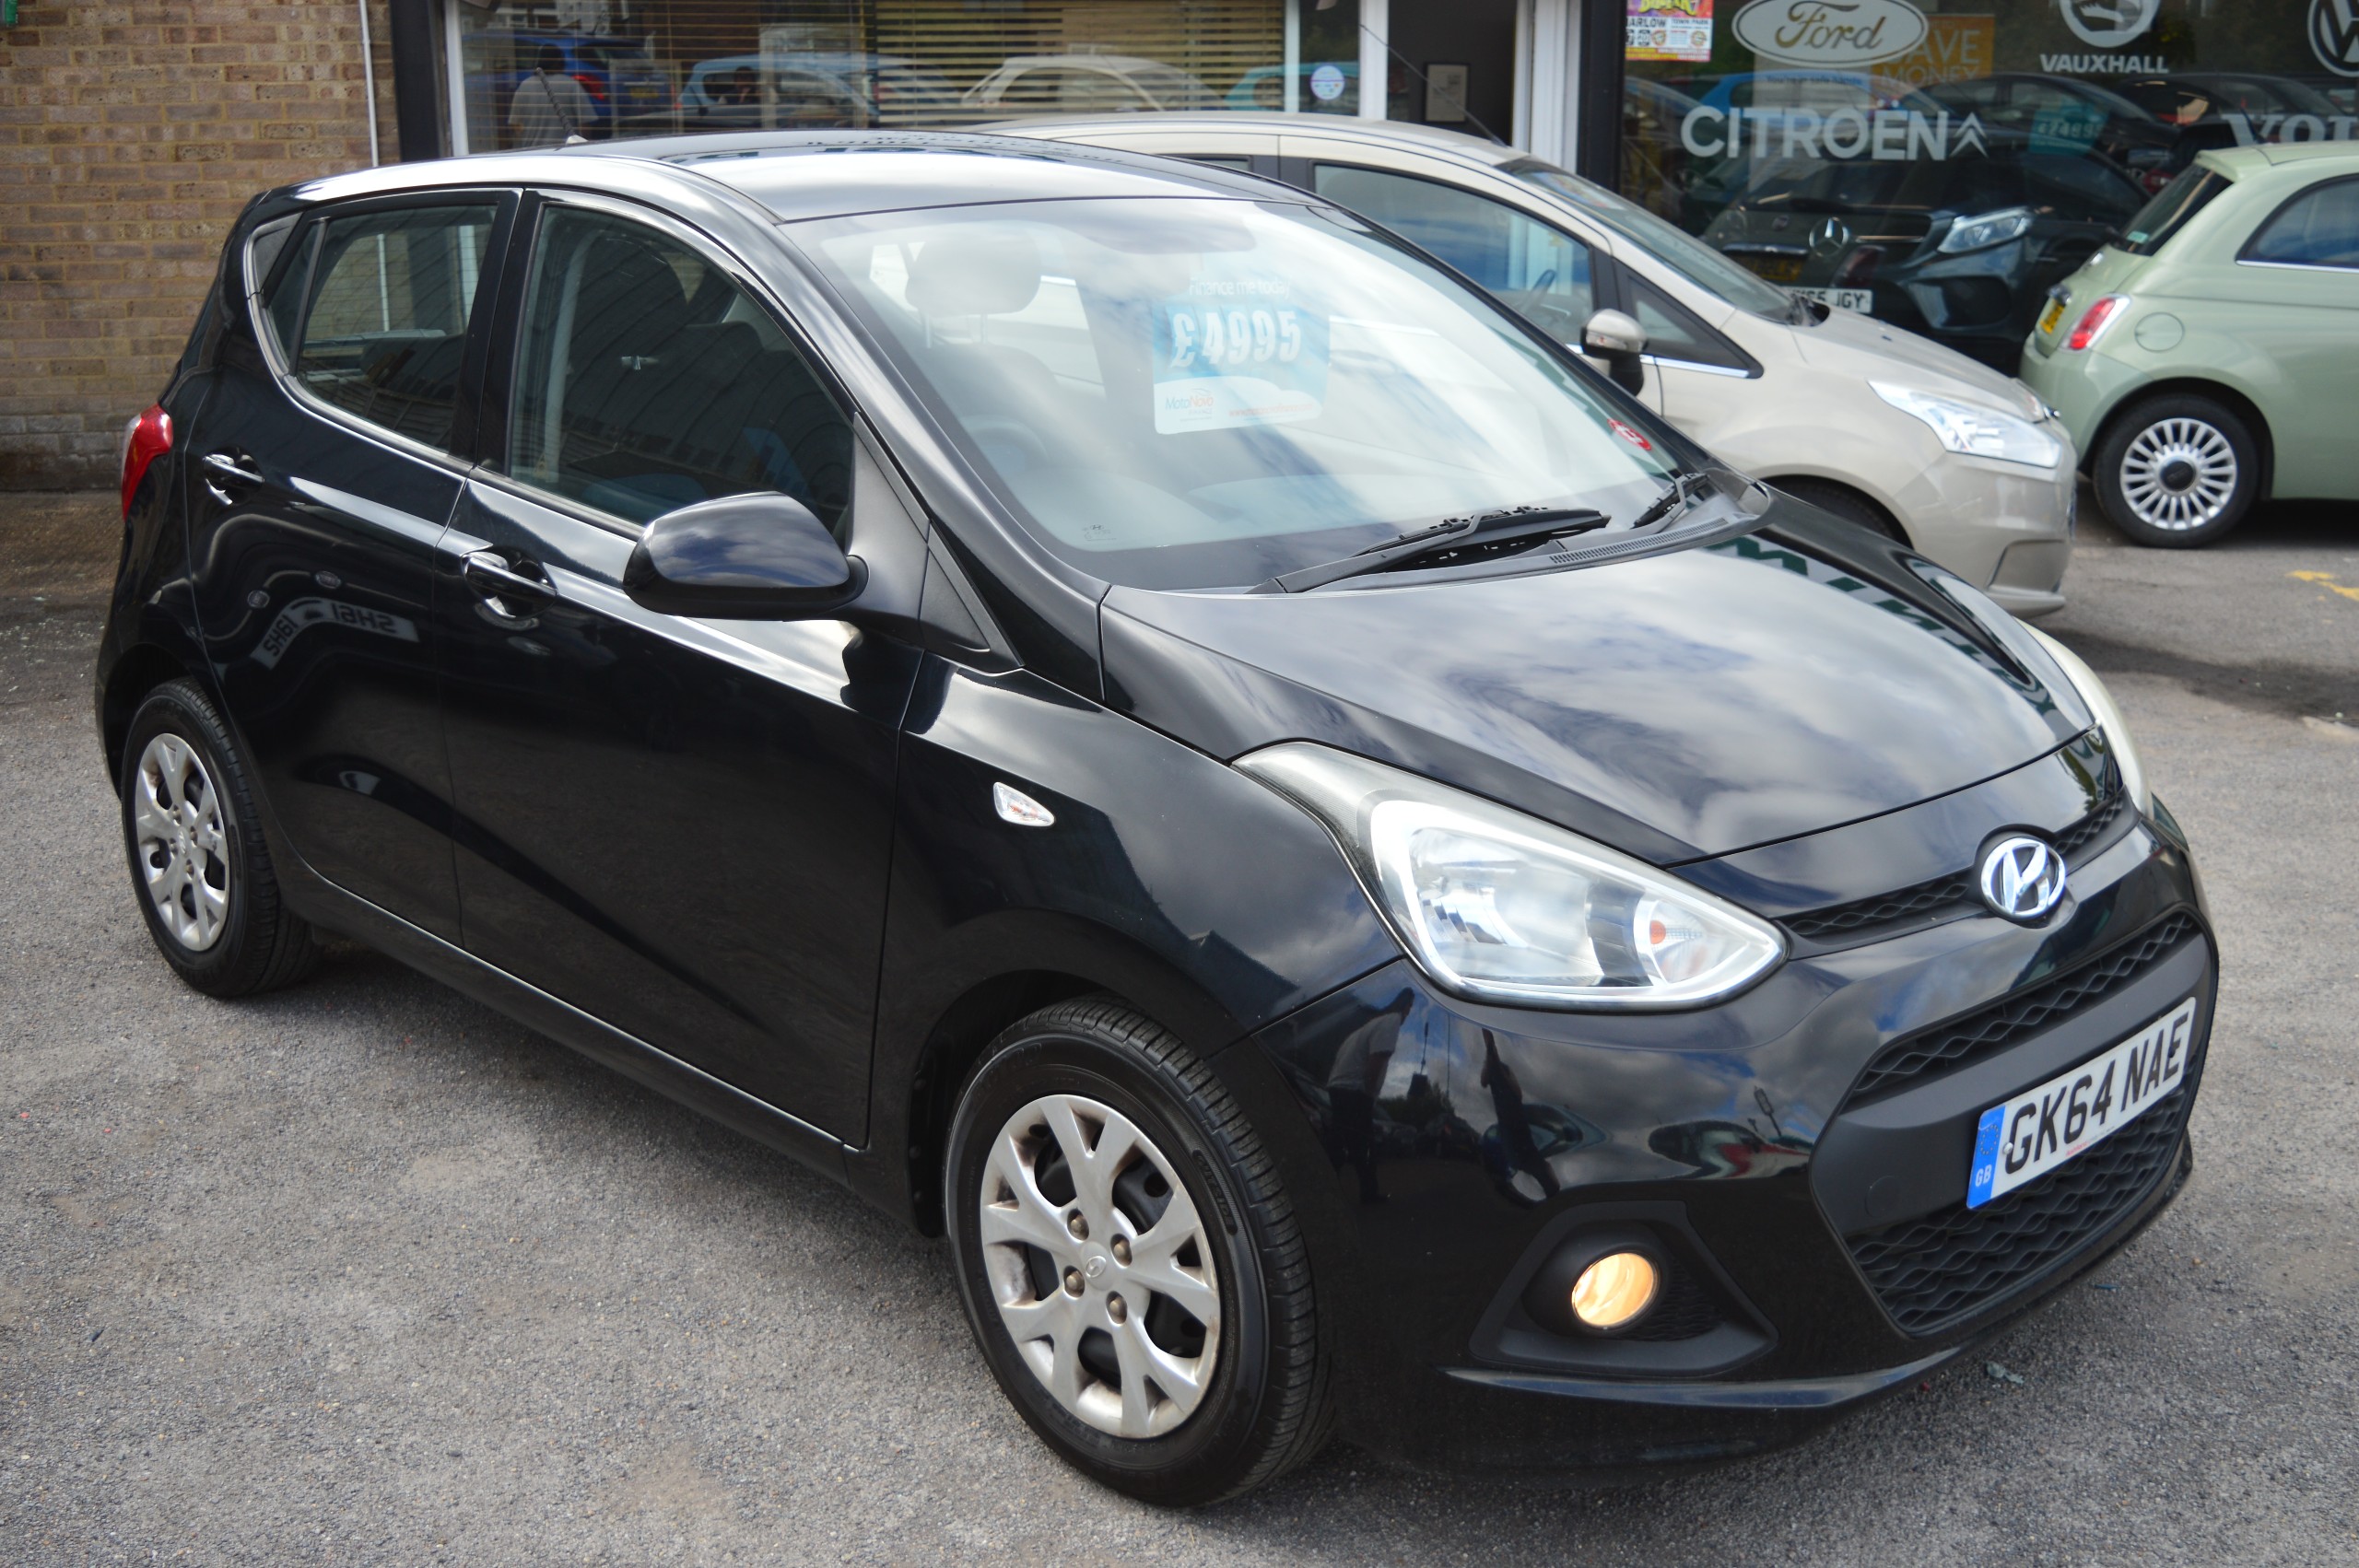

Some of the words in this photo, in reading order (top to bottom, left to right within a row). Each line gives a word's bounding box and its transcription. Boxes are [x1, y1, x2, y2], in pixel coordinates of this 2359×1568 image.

[1775, 0, 1887, 50] Ford
[2039, 53, 2170, 75] VAUXHALL
[1189, 277, 1235, 296] Finance
[1236, 280, 1257, 296] me
[1258, 277, 1291, 299] today
[1170, 310, 1301, 368] £4995
[2004, 1059, 2117, 1176] GK64
[2120, 1011, 2189, 1113] NAE
[1975, 1164, 1991, 1187] GB
